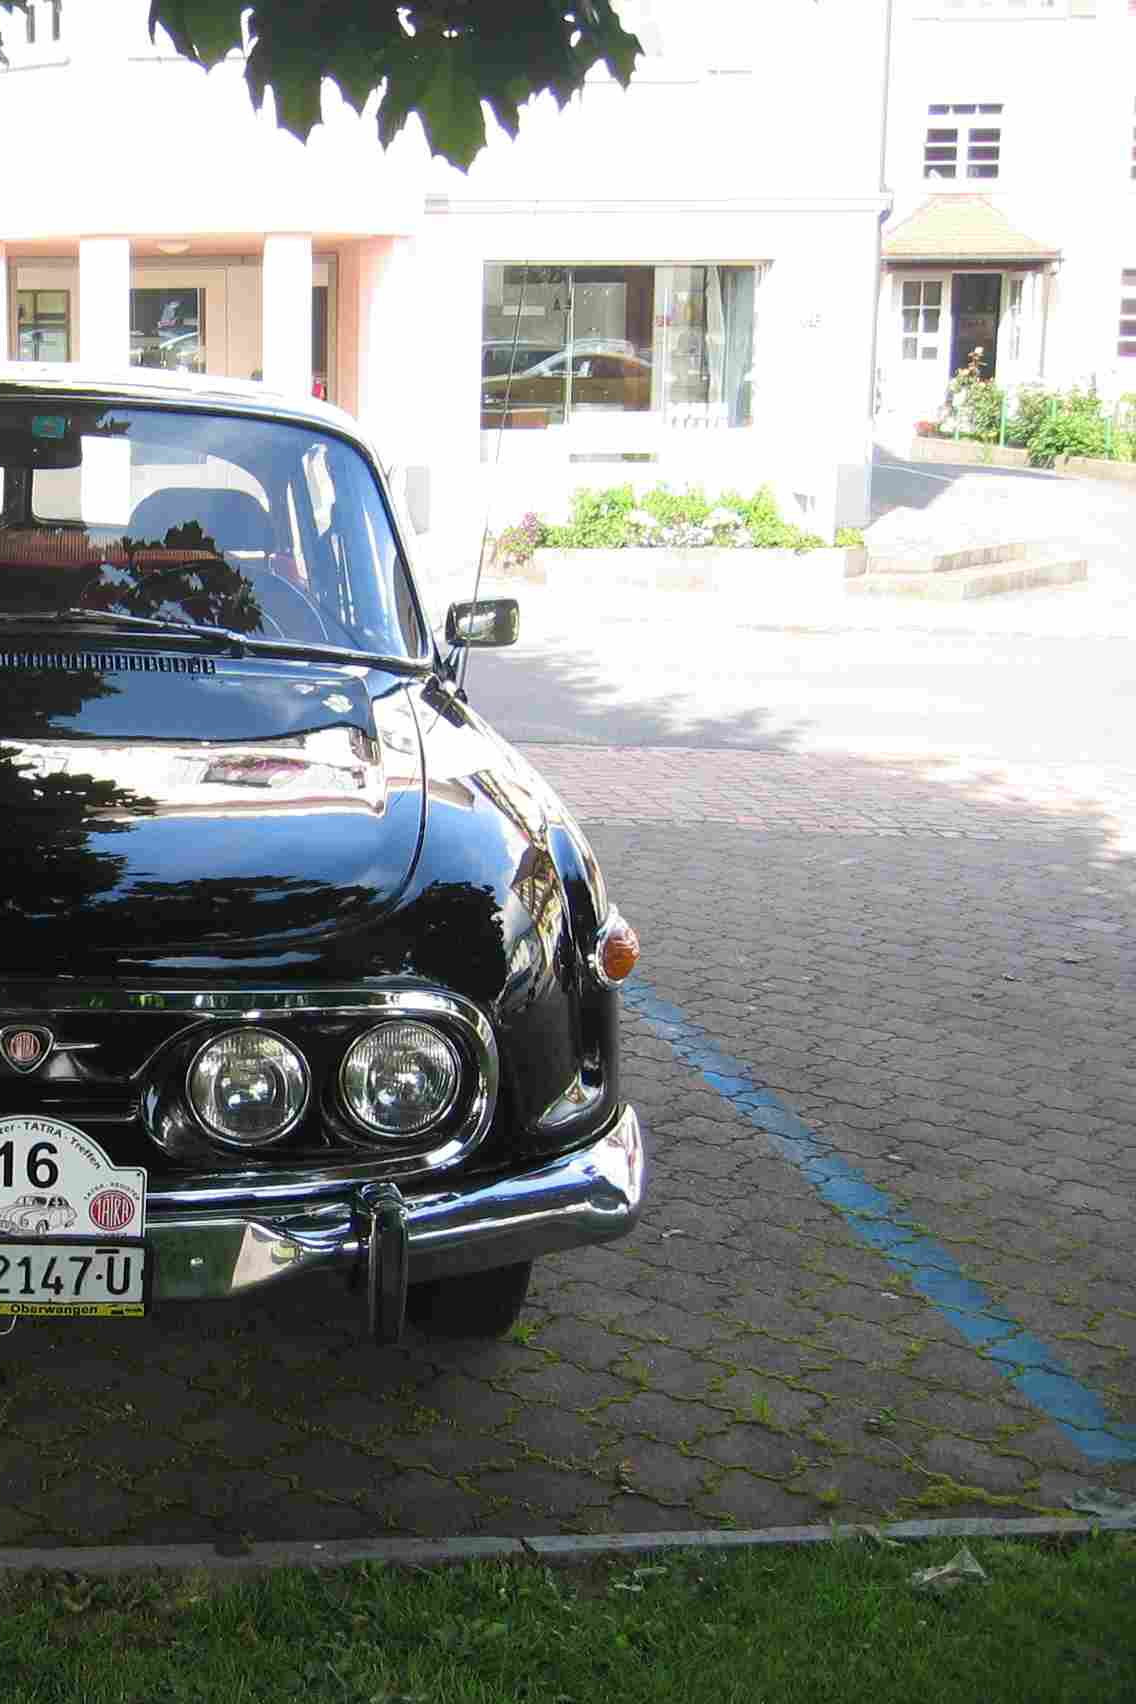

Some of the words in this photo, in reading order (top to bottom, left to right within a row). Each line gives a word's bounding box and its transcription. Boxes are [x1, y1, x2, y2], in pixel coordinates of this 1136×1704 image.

[23, 1121, 62, 1138] TATRA
[70, 1136, 102, 1169] Treffen
[10, 1303, 97, 1316] Oberwangen
